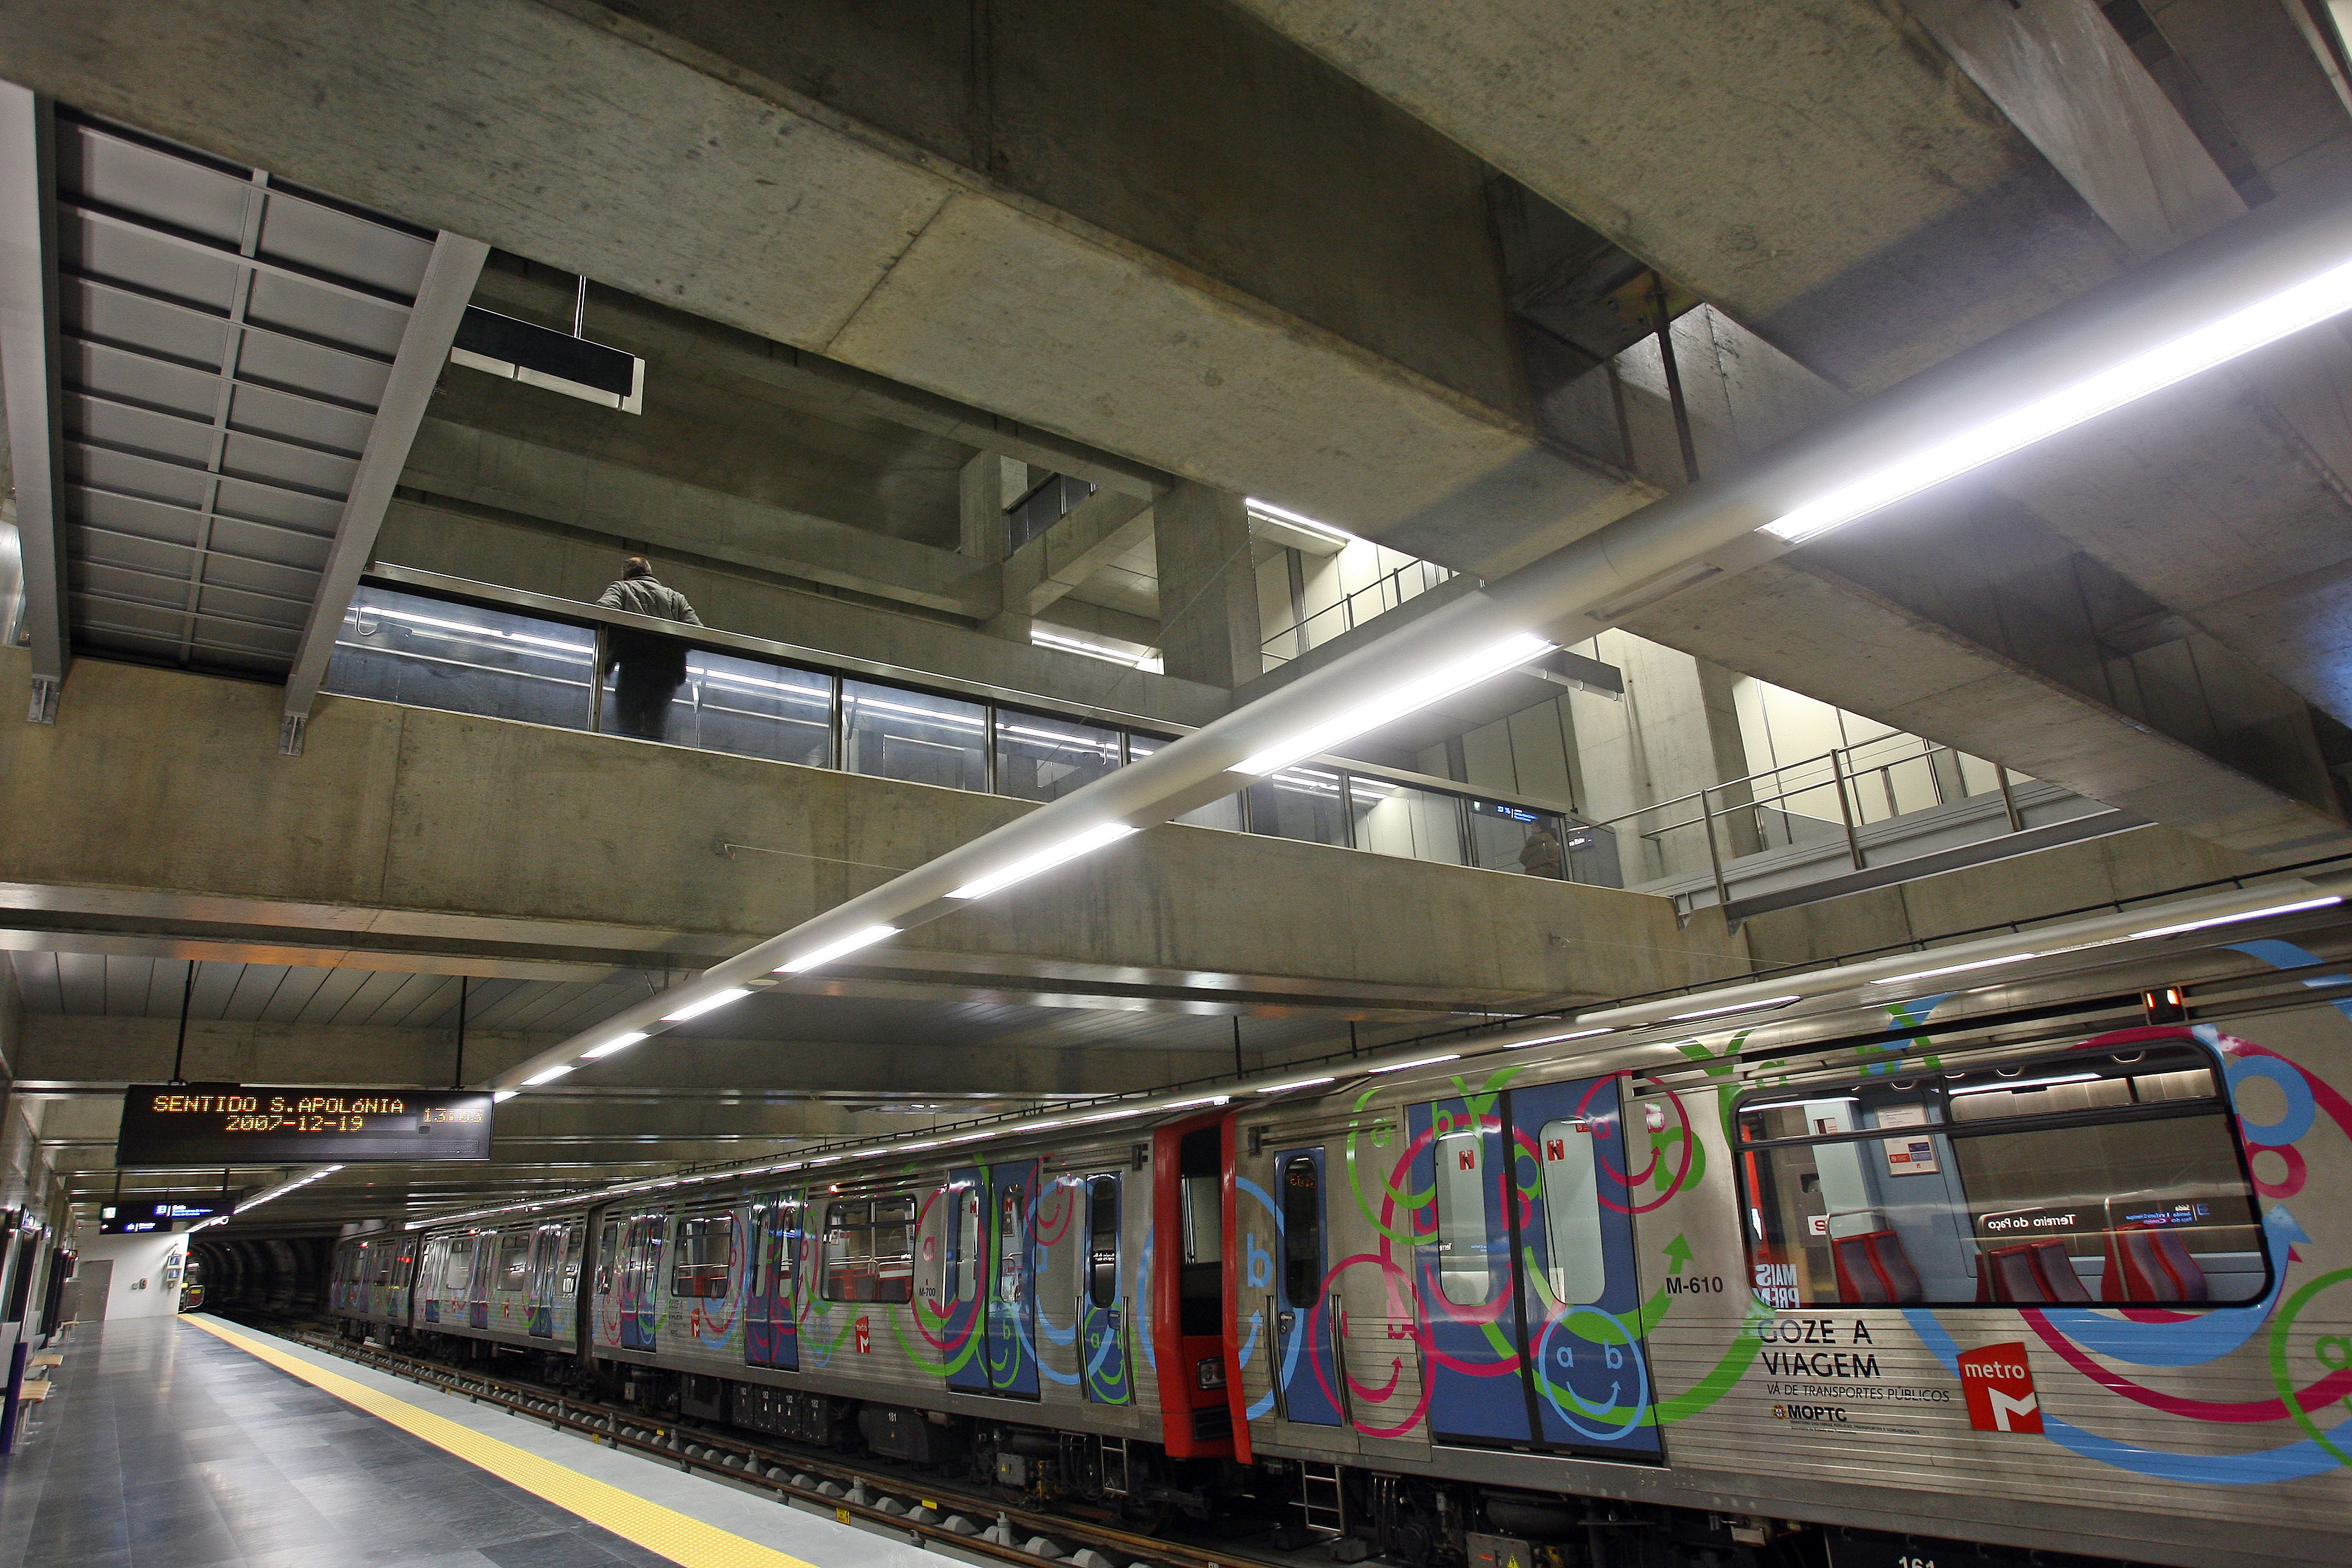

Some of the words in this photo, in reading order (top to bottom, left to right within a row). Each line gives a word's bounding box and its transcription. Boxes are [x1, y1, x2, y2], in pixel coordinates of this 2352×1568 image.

[154, 1095, 256, 1112] SENTIDO
[225, 1115, 364, 1132] 2007-12-19
[423, 1106, 484, 1123] 13:03
[919, 1287, 936, 1297] M-700
[1666, 1276, 1723, 1294] M-610
[1757, 1319, 1837, 1344] GOZE
[1853, 1319, 1873, 1344] A
[1556, 1347, 1574, 1368] a
[1604, 1339, 1623, 1370] b
[1761, 1351, 1881, 1379] VIAGEM
[1964, 1361, 2025, 1379] metro
[1766, 1381, 1780, 1395] VÁ
[1785, 1383, 1798, 1396] DE
[1803, 1385, 1883, 1400] TRANSPORTES
[1887, 1385, 1950, 1402] PÚBLICOS
[1787, 1404, 1847, 1422] MOPTC
